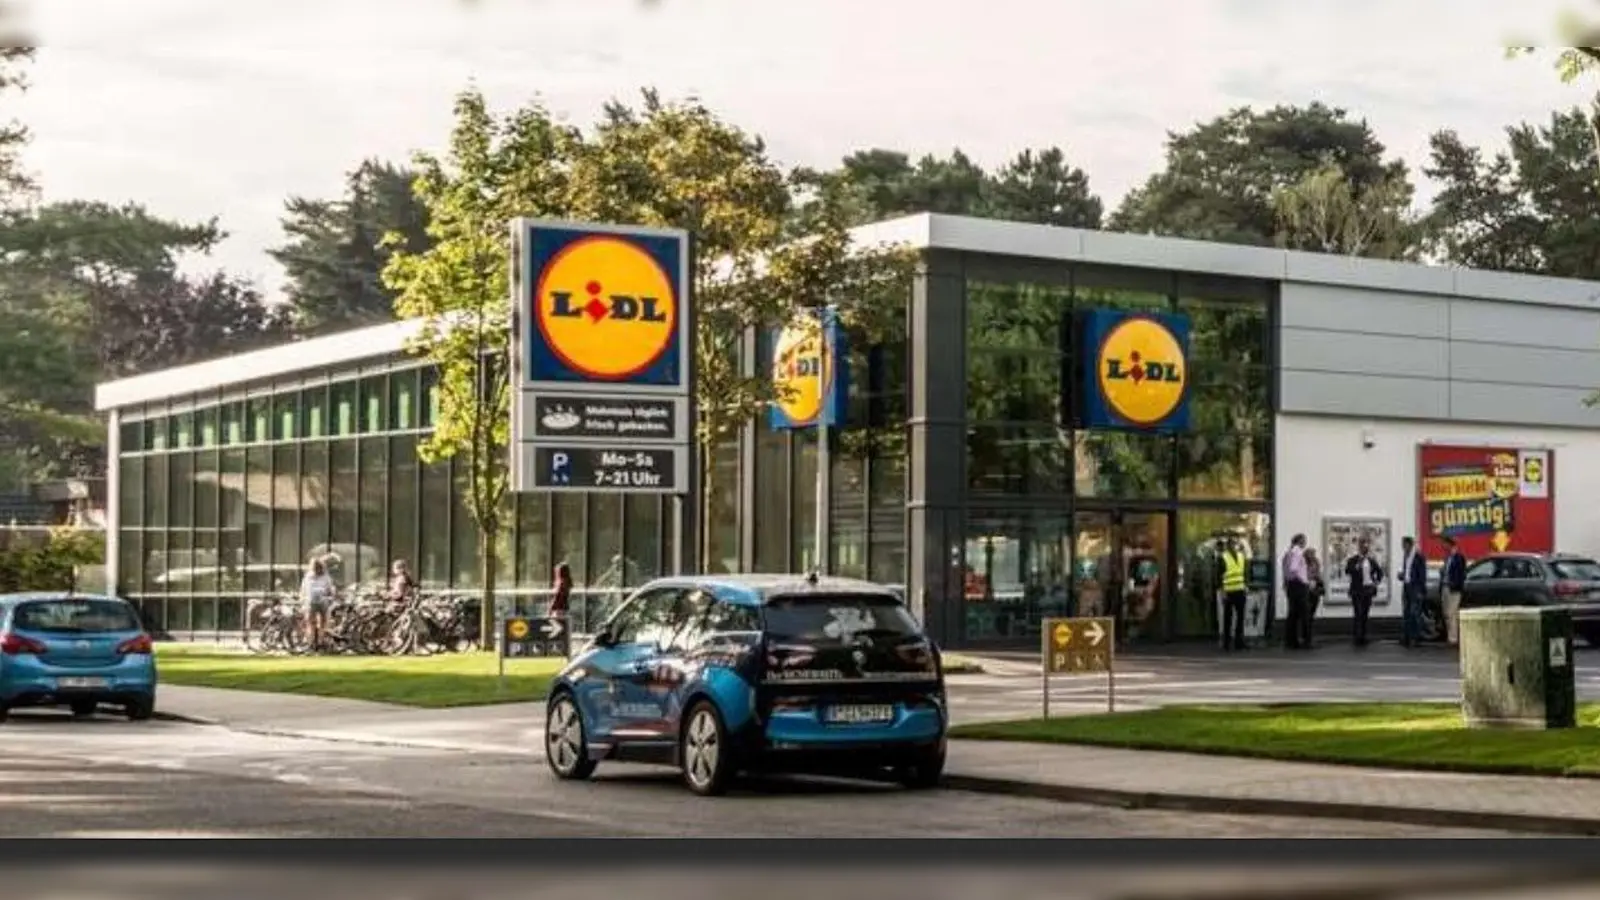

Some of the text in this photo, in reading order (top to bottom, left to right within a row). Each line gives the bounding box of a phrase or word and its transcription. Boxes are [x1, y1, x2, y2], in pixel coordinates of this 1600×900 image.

[553, 453, 568, 471] P
[632, 471, 661, 485] Uhr
[1431, 499, 1511, 535] günstig!
